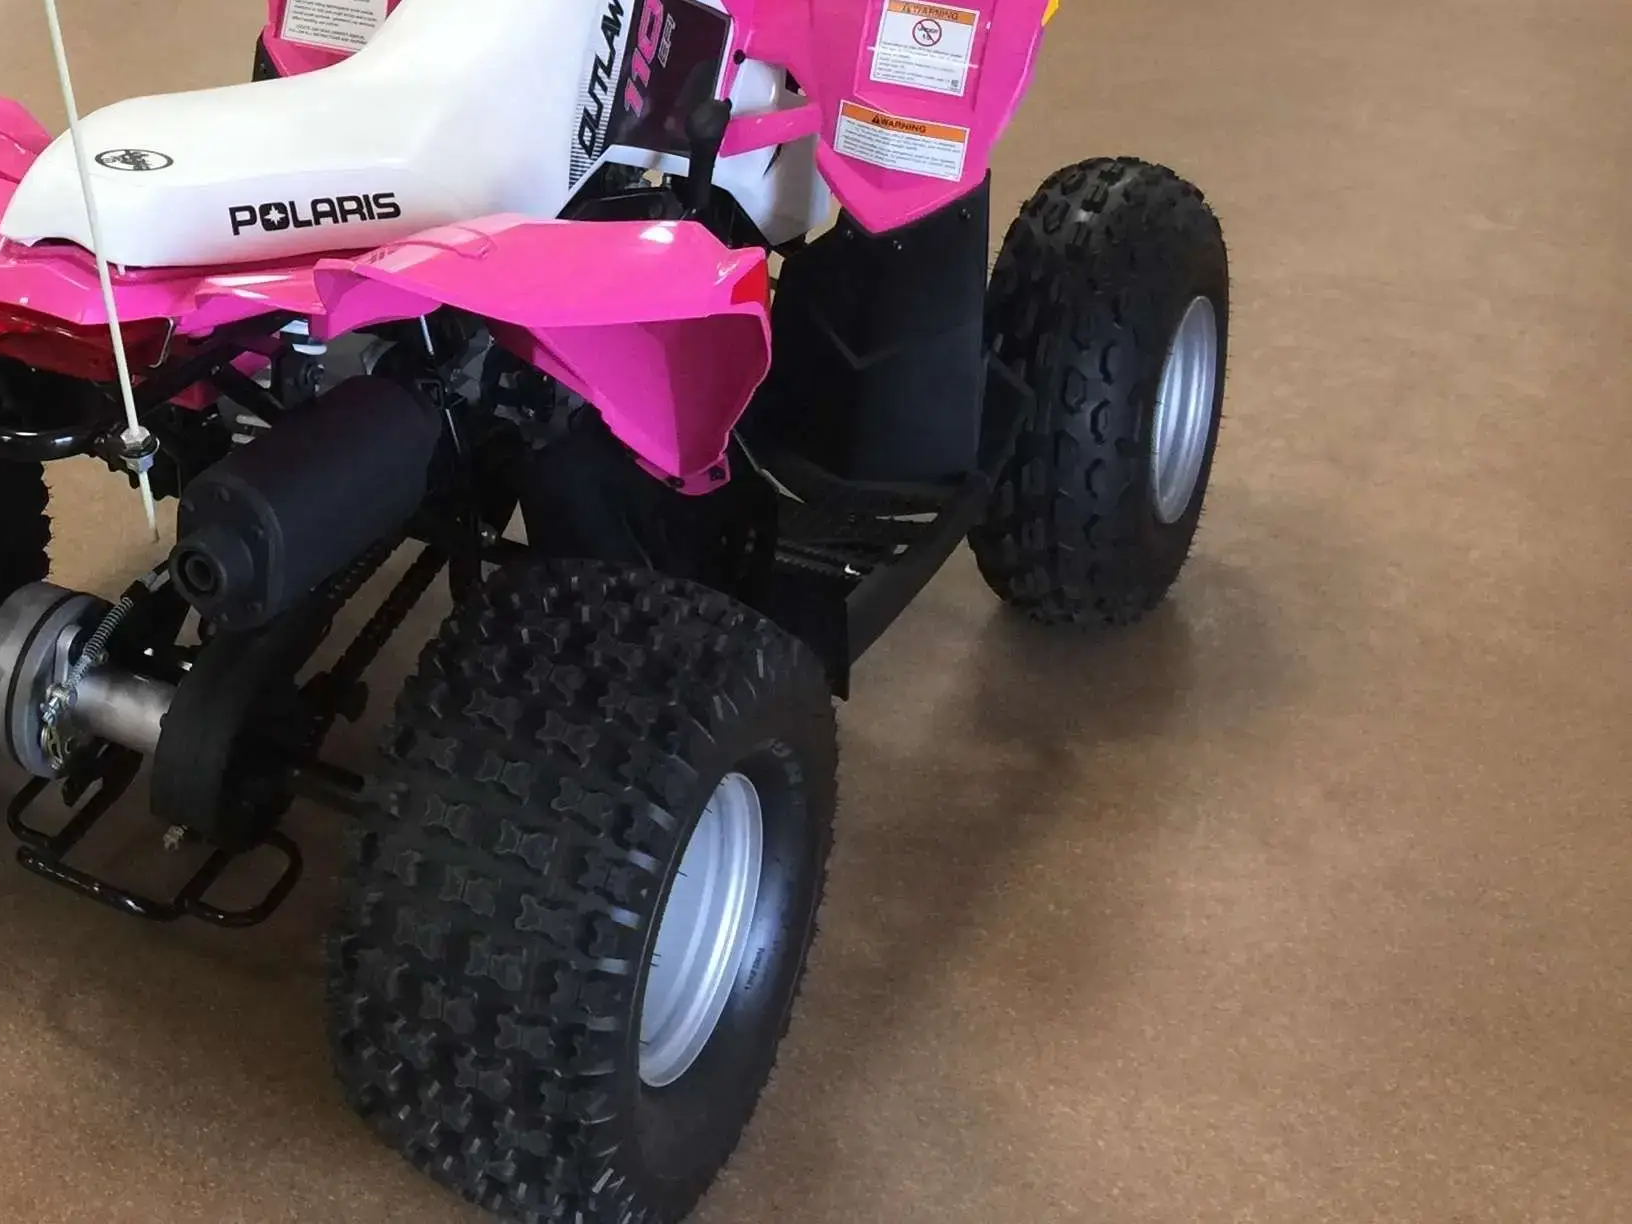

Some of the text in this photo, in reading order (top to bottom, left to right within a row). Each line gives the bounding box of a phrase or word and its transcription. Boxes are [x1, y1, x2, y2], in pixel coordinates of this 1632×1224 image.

[911, 2, 960, 22] WARNING
[879, 116, 927, 135] WARNING
[228, 192, 401, 236] POLARIS
